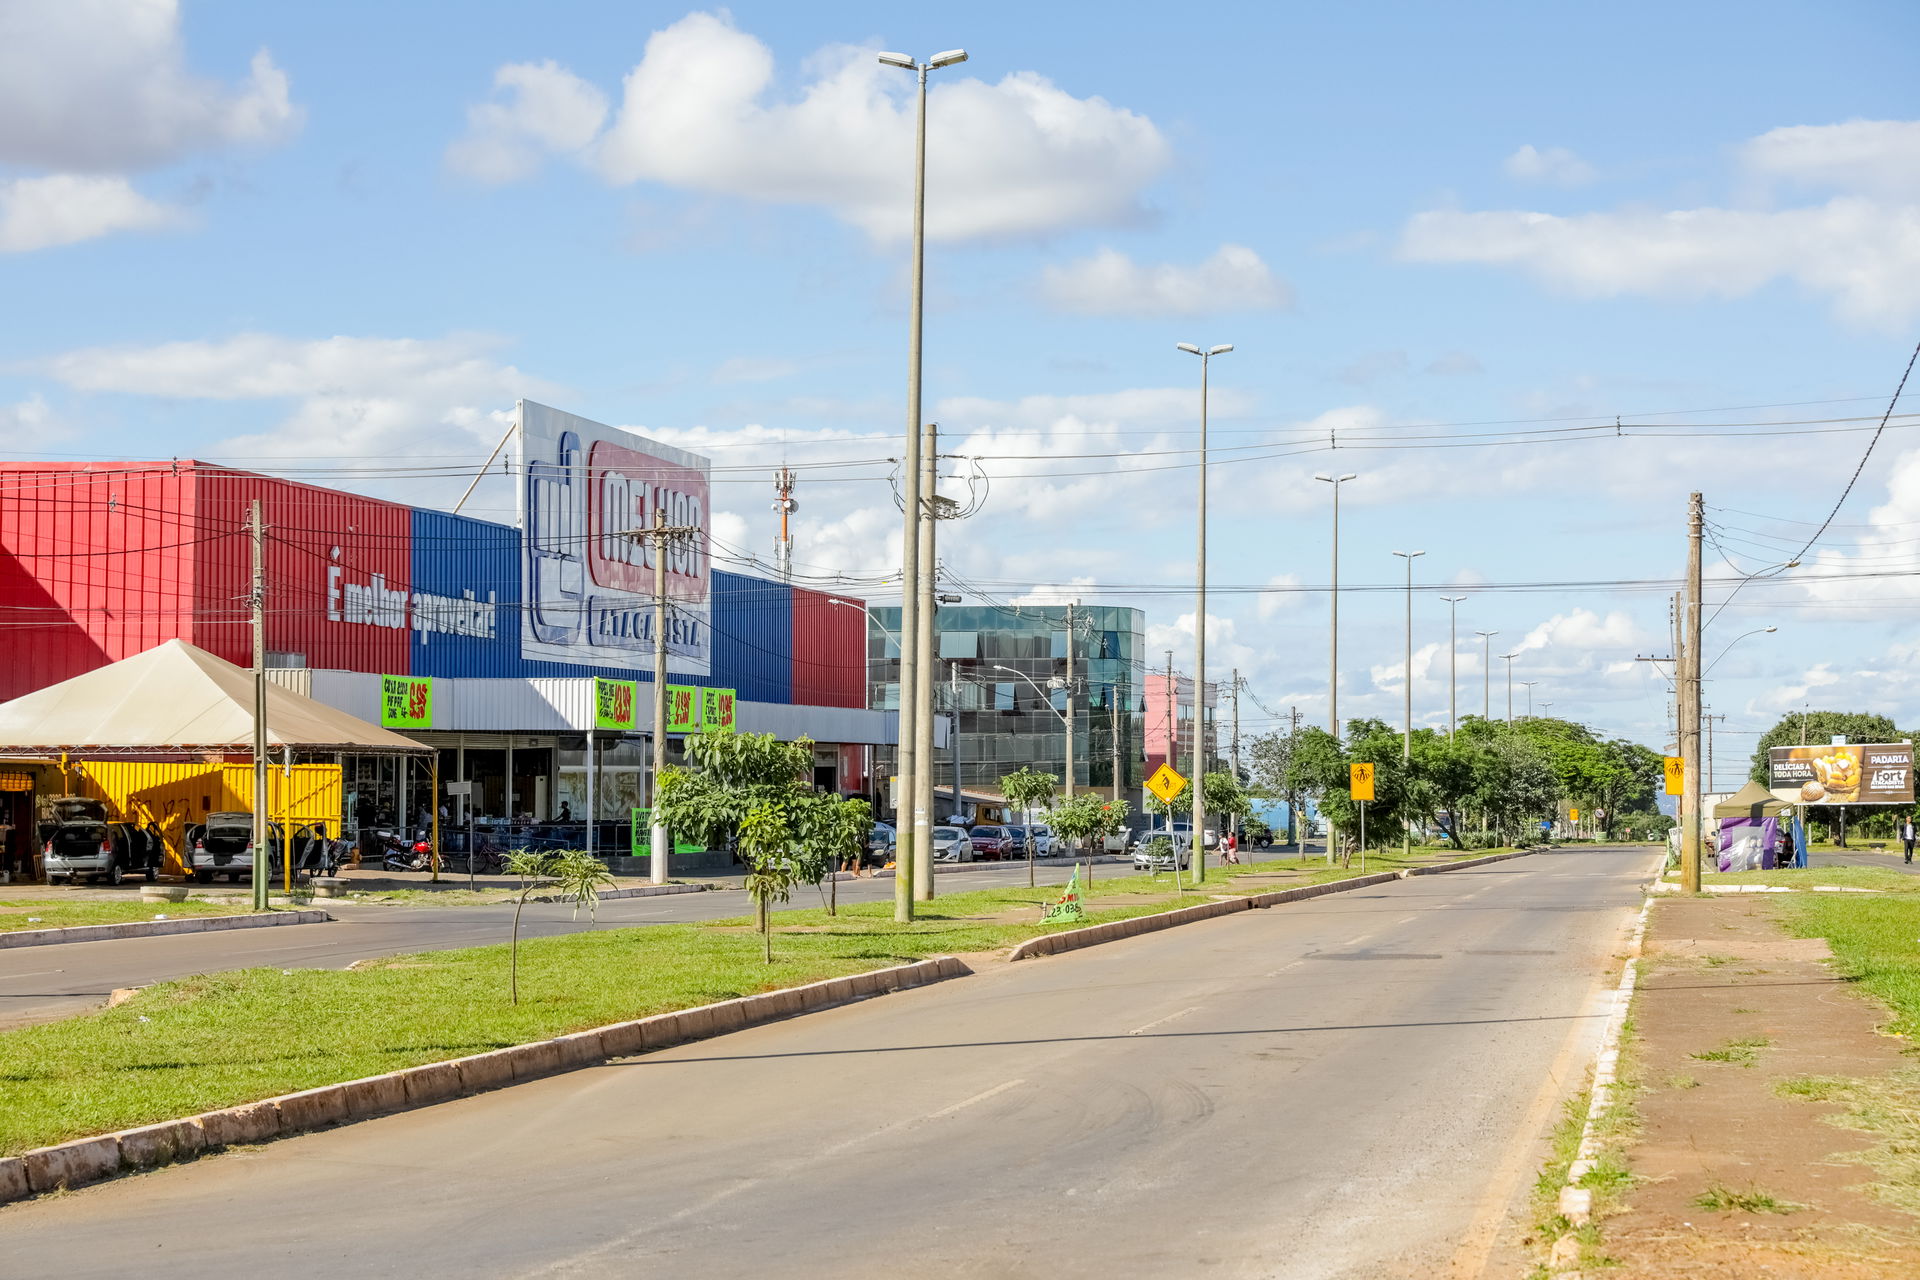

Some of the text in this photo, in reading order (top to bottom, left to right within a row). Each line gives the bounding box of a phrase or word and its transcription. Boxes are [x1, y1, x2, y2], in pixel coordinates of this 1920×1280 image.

[600, 470, 702, 578] MELHOR
[328, 545, 496, 646] É melhor aproveitar!
[599, 608, 701, 646] ATACAISTA
[1871, 755, 1909, 764] PADARIA
[1774, 762, 1803, 771] DELÍCIAS
[1792, 770, 1814, 778] HORA.
[1876, 770, 1903, 781] Fort
